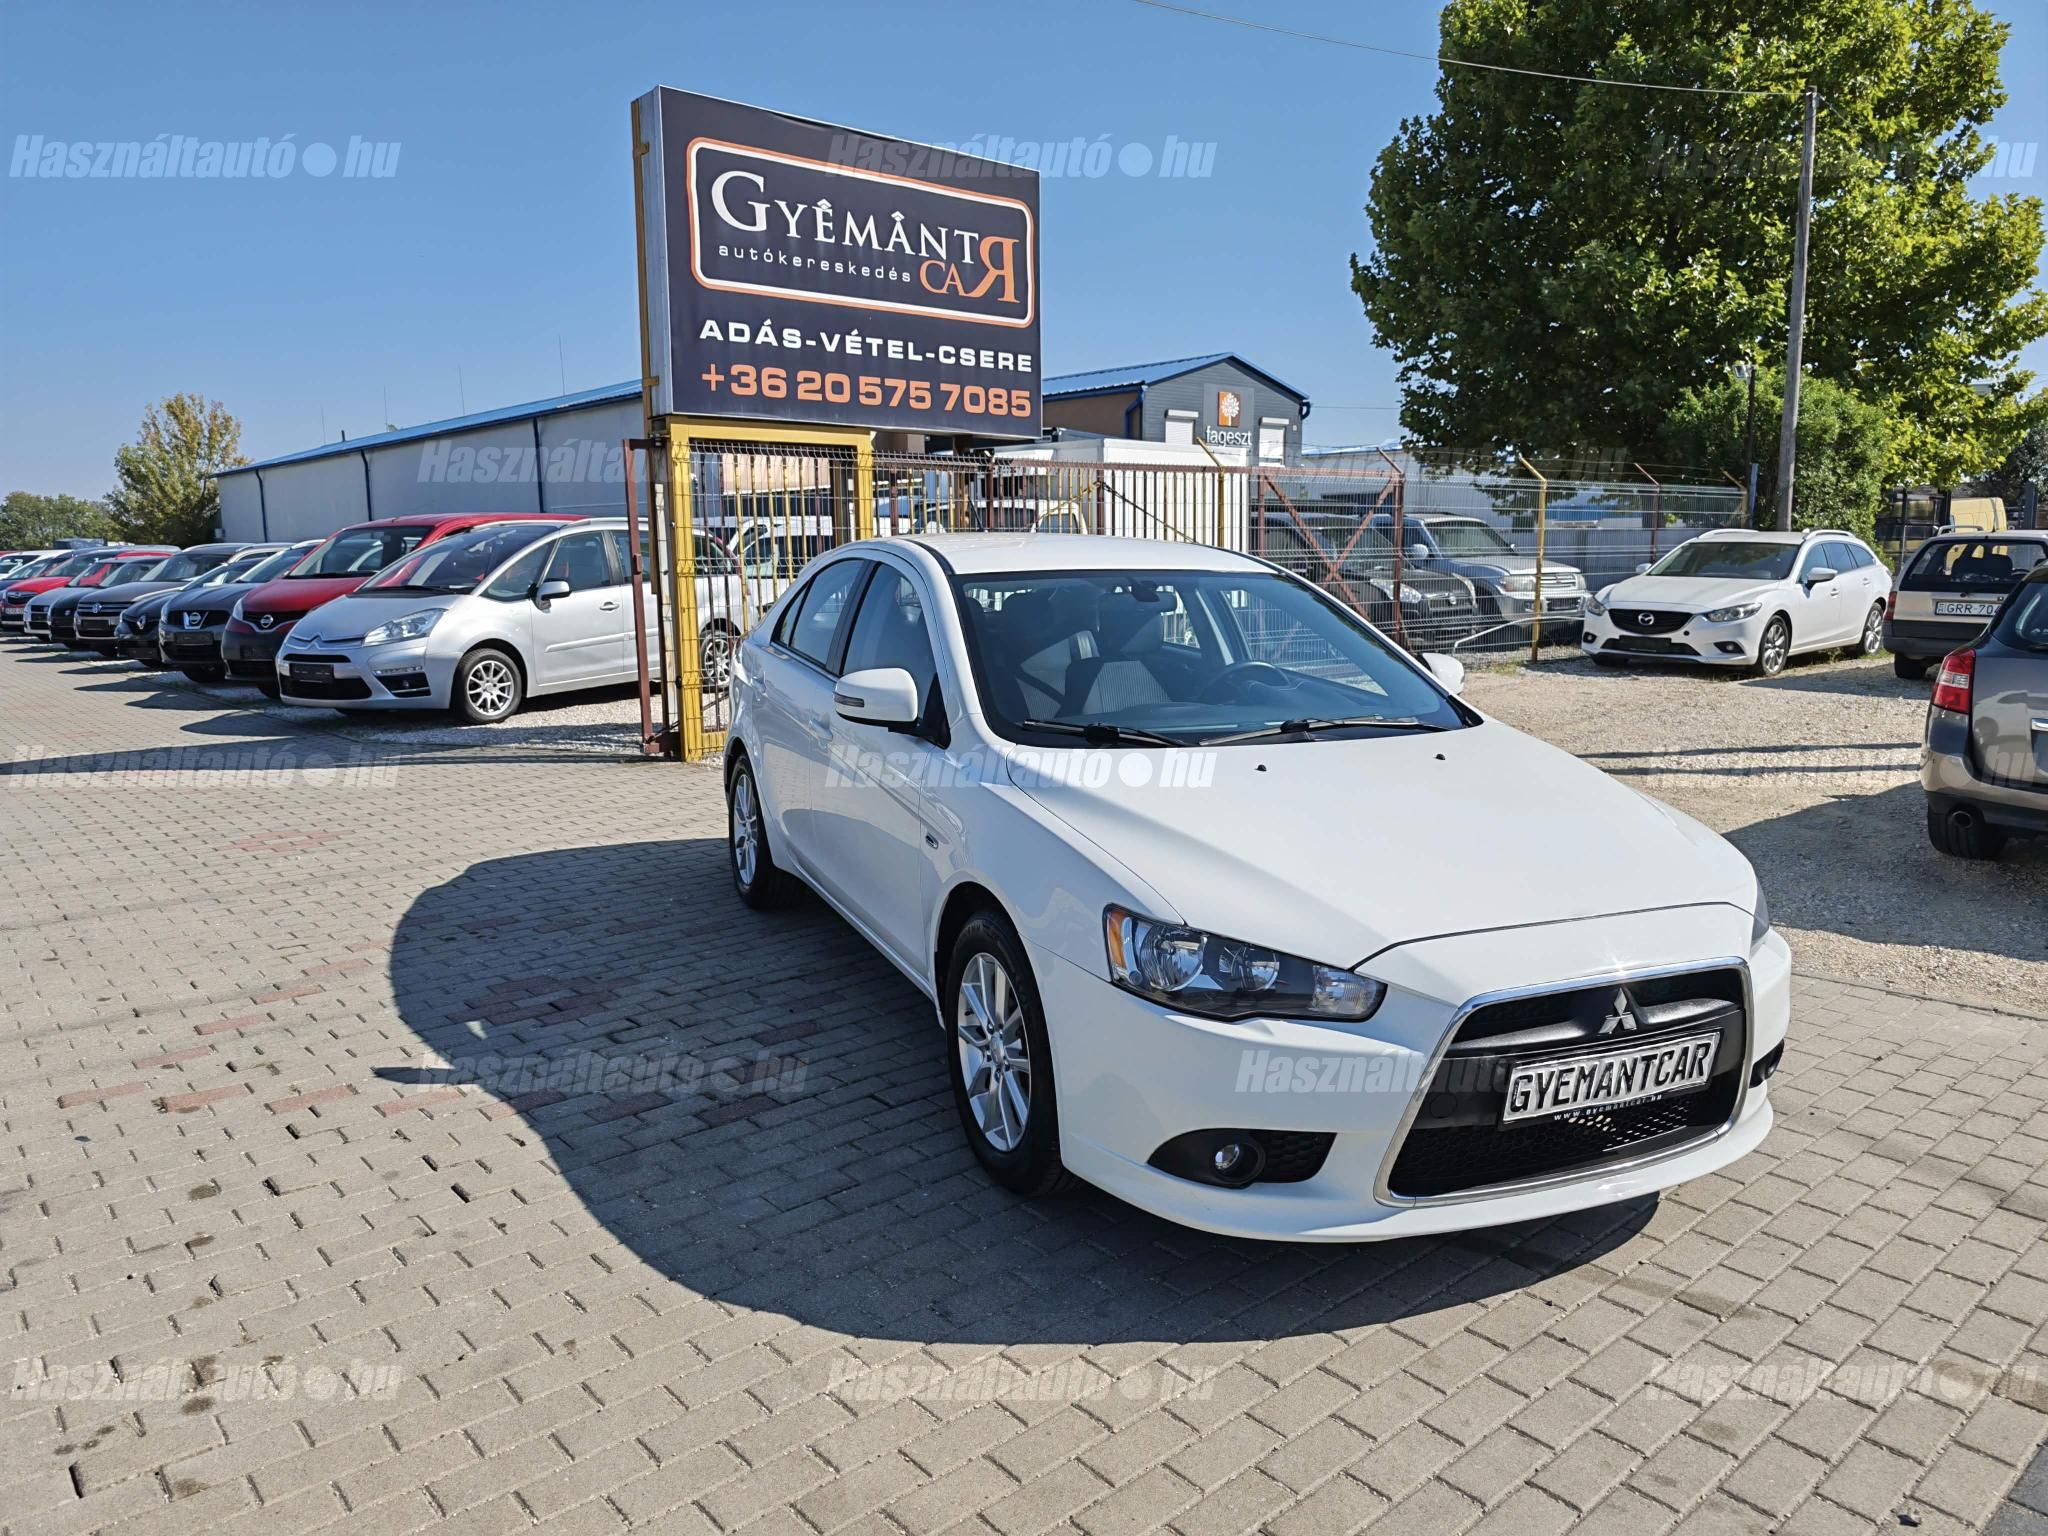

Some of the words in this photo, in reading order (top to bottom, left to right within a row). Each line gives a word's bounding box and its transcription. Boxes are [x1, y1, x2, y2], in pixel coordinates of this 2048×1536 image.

[718, 245, 912, 283] autókereskedés
[700, 319, 1032, 373] ADÁS-VÉTEL-CSERE
[702, 363, 787, 399] +36
[796, 370, 851, 404] 20
[859, 376, 931, 411] 575
[939, 384, 1032, 418] 7085
[1205, 426, 1252, 446] fageszt
[1510, 1041, 1713, 1113] GYEMANTCAR
